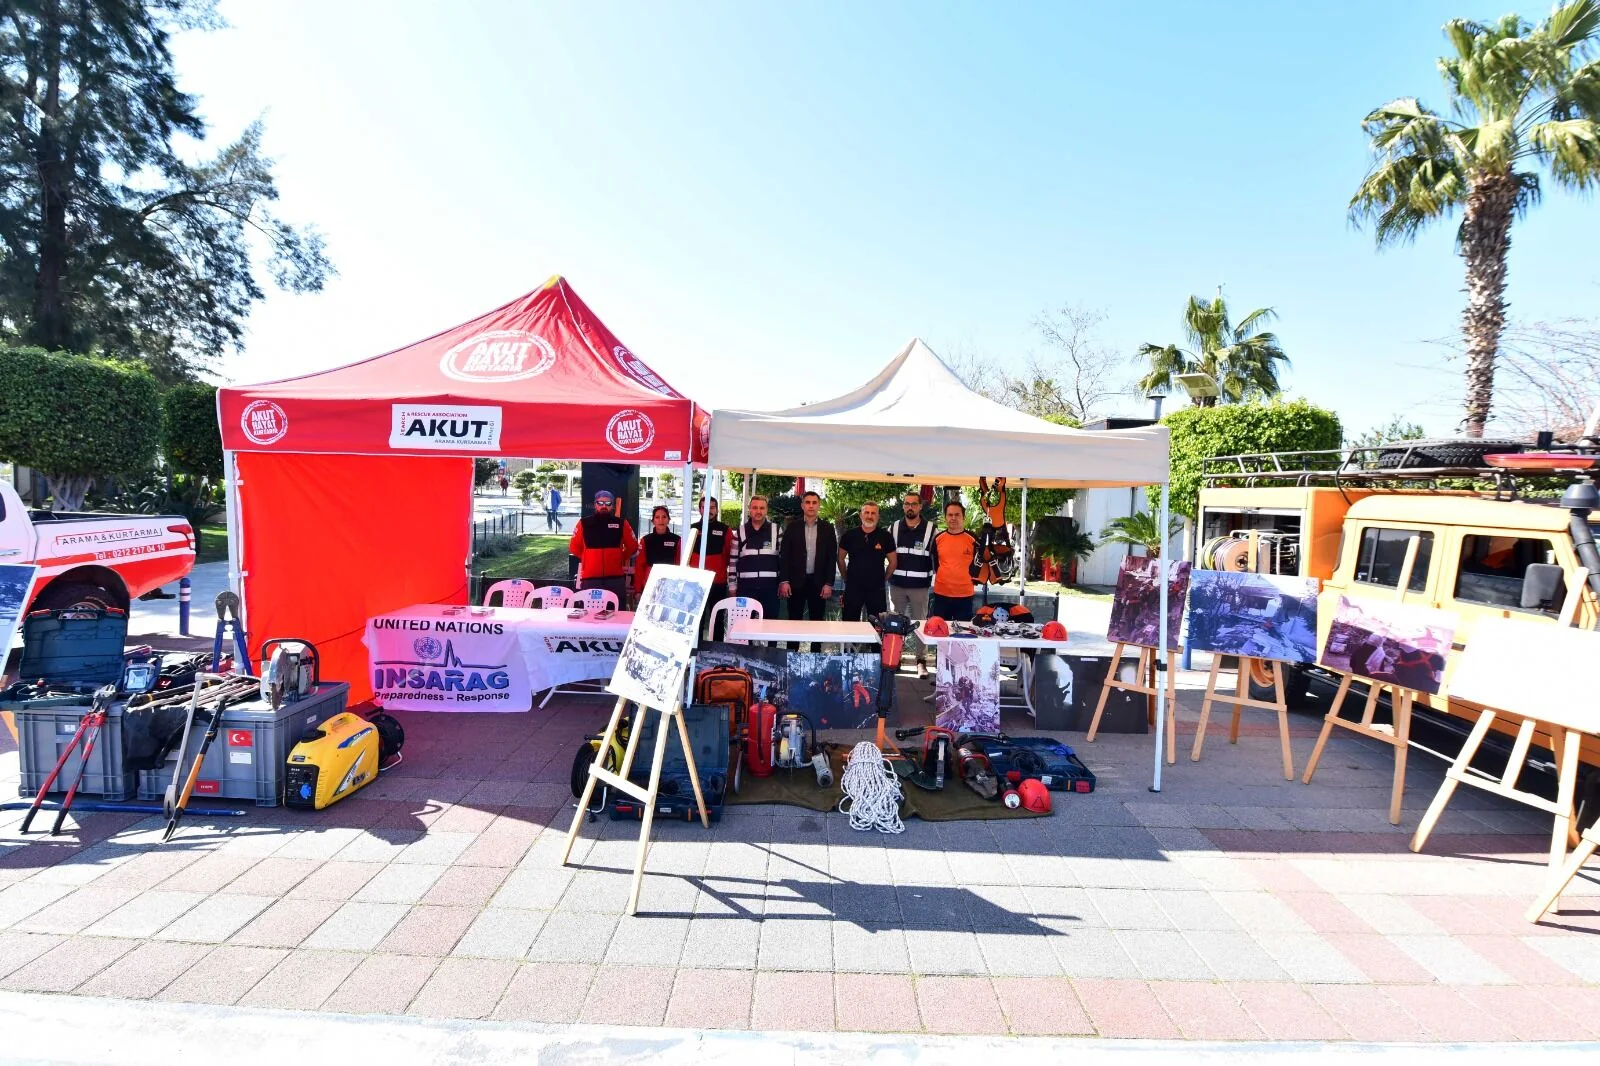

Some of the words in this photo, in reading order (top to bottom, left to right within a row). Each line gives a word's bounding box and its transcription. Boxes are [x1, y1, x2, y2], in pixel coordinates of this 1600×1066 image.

[252, 410, 275, 421] AKUT
[404, 419, 488, 438] AKUT
[618, 419, 642, 432] AKUT
[112, 548, 132, 558] 0212
[132, 546, 145, 555] 217
[146, 544, 156, 552] 04
[157, 543, 166, 551] 10
[373, 618, 431, 631] UNITED
[435, 621, 504, 635] NATIONS
[555, 641, 624, 653] AKU
[374, 668, 510, 691] INSARAG
[374, 691, 445, 702] Preparedness
[456, 692, 510, 702] Response
